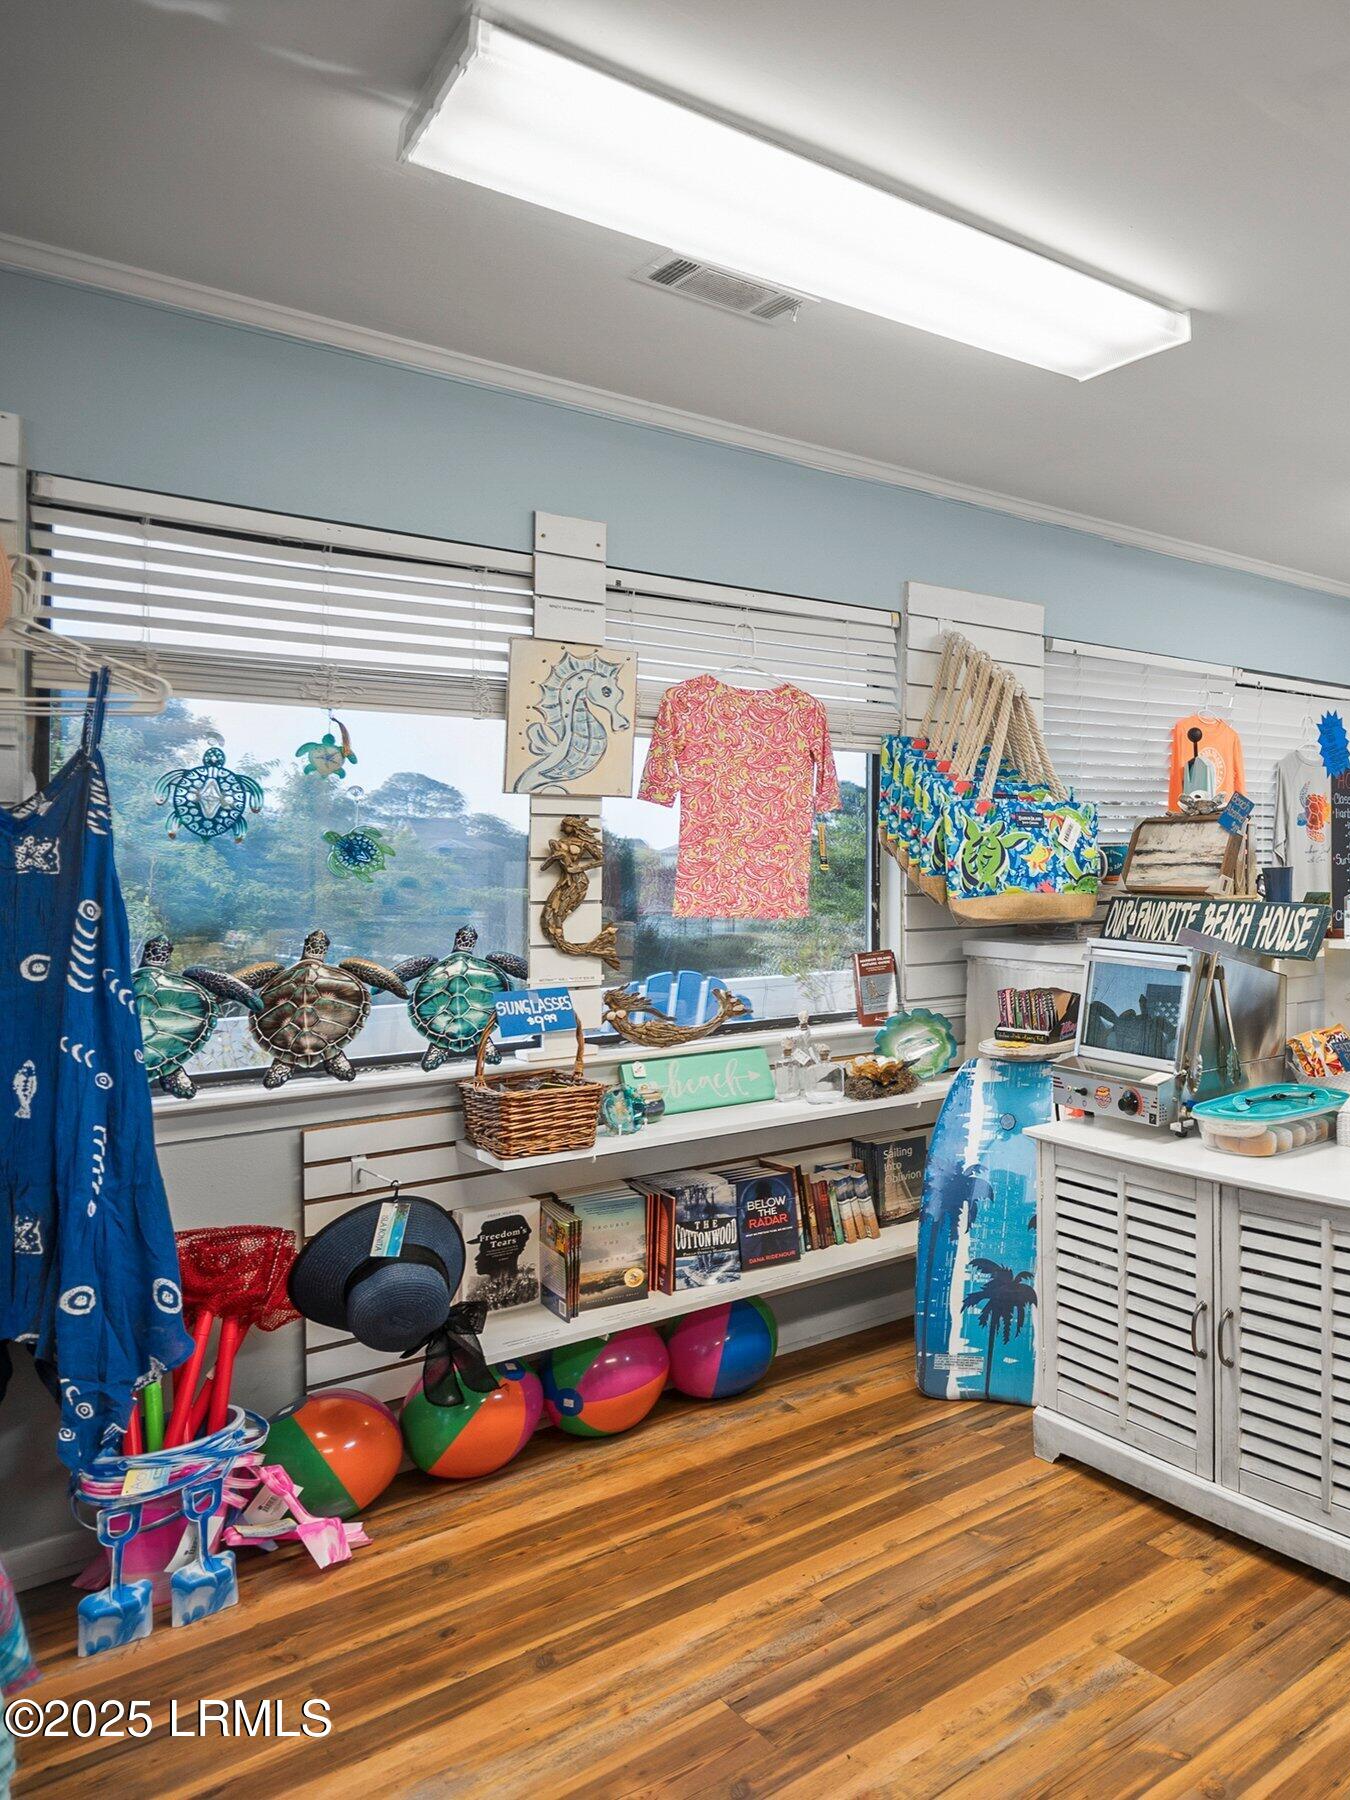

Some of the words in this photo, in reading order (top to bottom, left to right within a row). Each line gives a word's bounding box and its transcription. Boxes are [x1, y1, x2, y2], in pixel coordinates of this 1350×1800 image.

[1104, 899, 1134, 939] OUR
[1133, 900, 1202, 942] FAVORITE
[1201, 901, 1257, 948] BEACH
[1252, 904, 1320, 952] HOUSE
[495, 994, 573, 1016] SUNGLASSES
[664, 1058, 750, 1098] beach
[883, 1146, 913, 1160] Sailing
[883, 1161, 902, 1172] Into
[885, 1169, 921, 1183] Oblivion
[747, 1195, 787, 1211] BELOW
[757, 1208, 778, 1217] THE
[694, 1219, 718, 1230] THE
[749, 1213, 789, 1229] RADAR
[479, 1225, 528, 1243] Freedom's
[675, 1218, 738, 1250] COTTONWOOD
[490, 1238, 517, 1249] Tears
[749, 1256, 766, 1264] DANA
